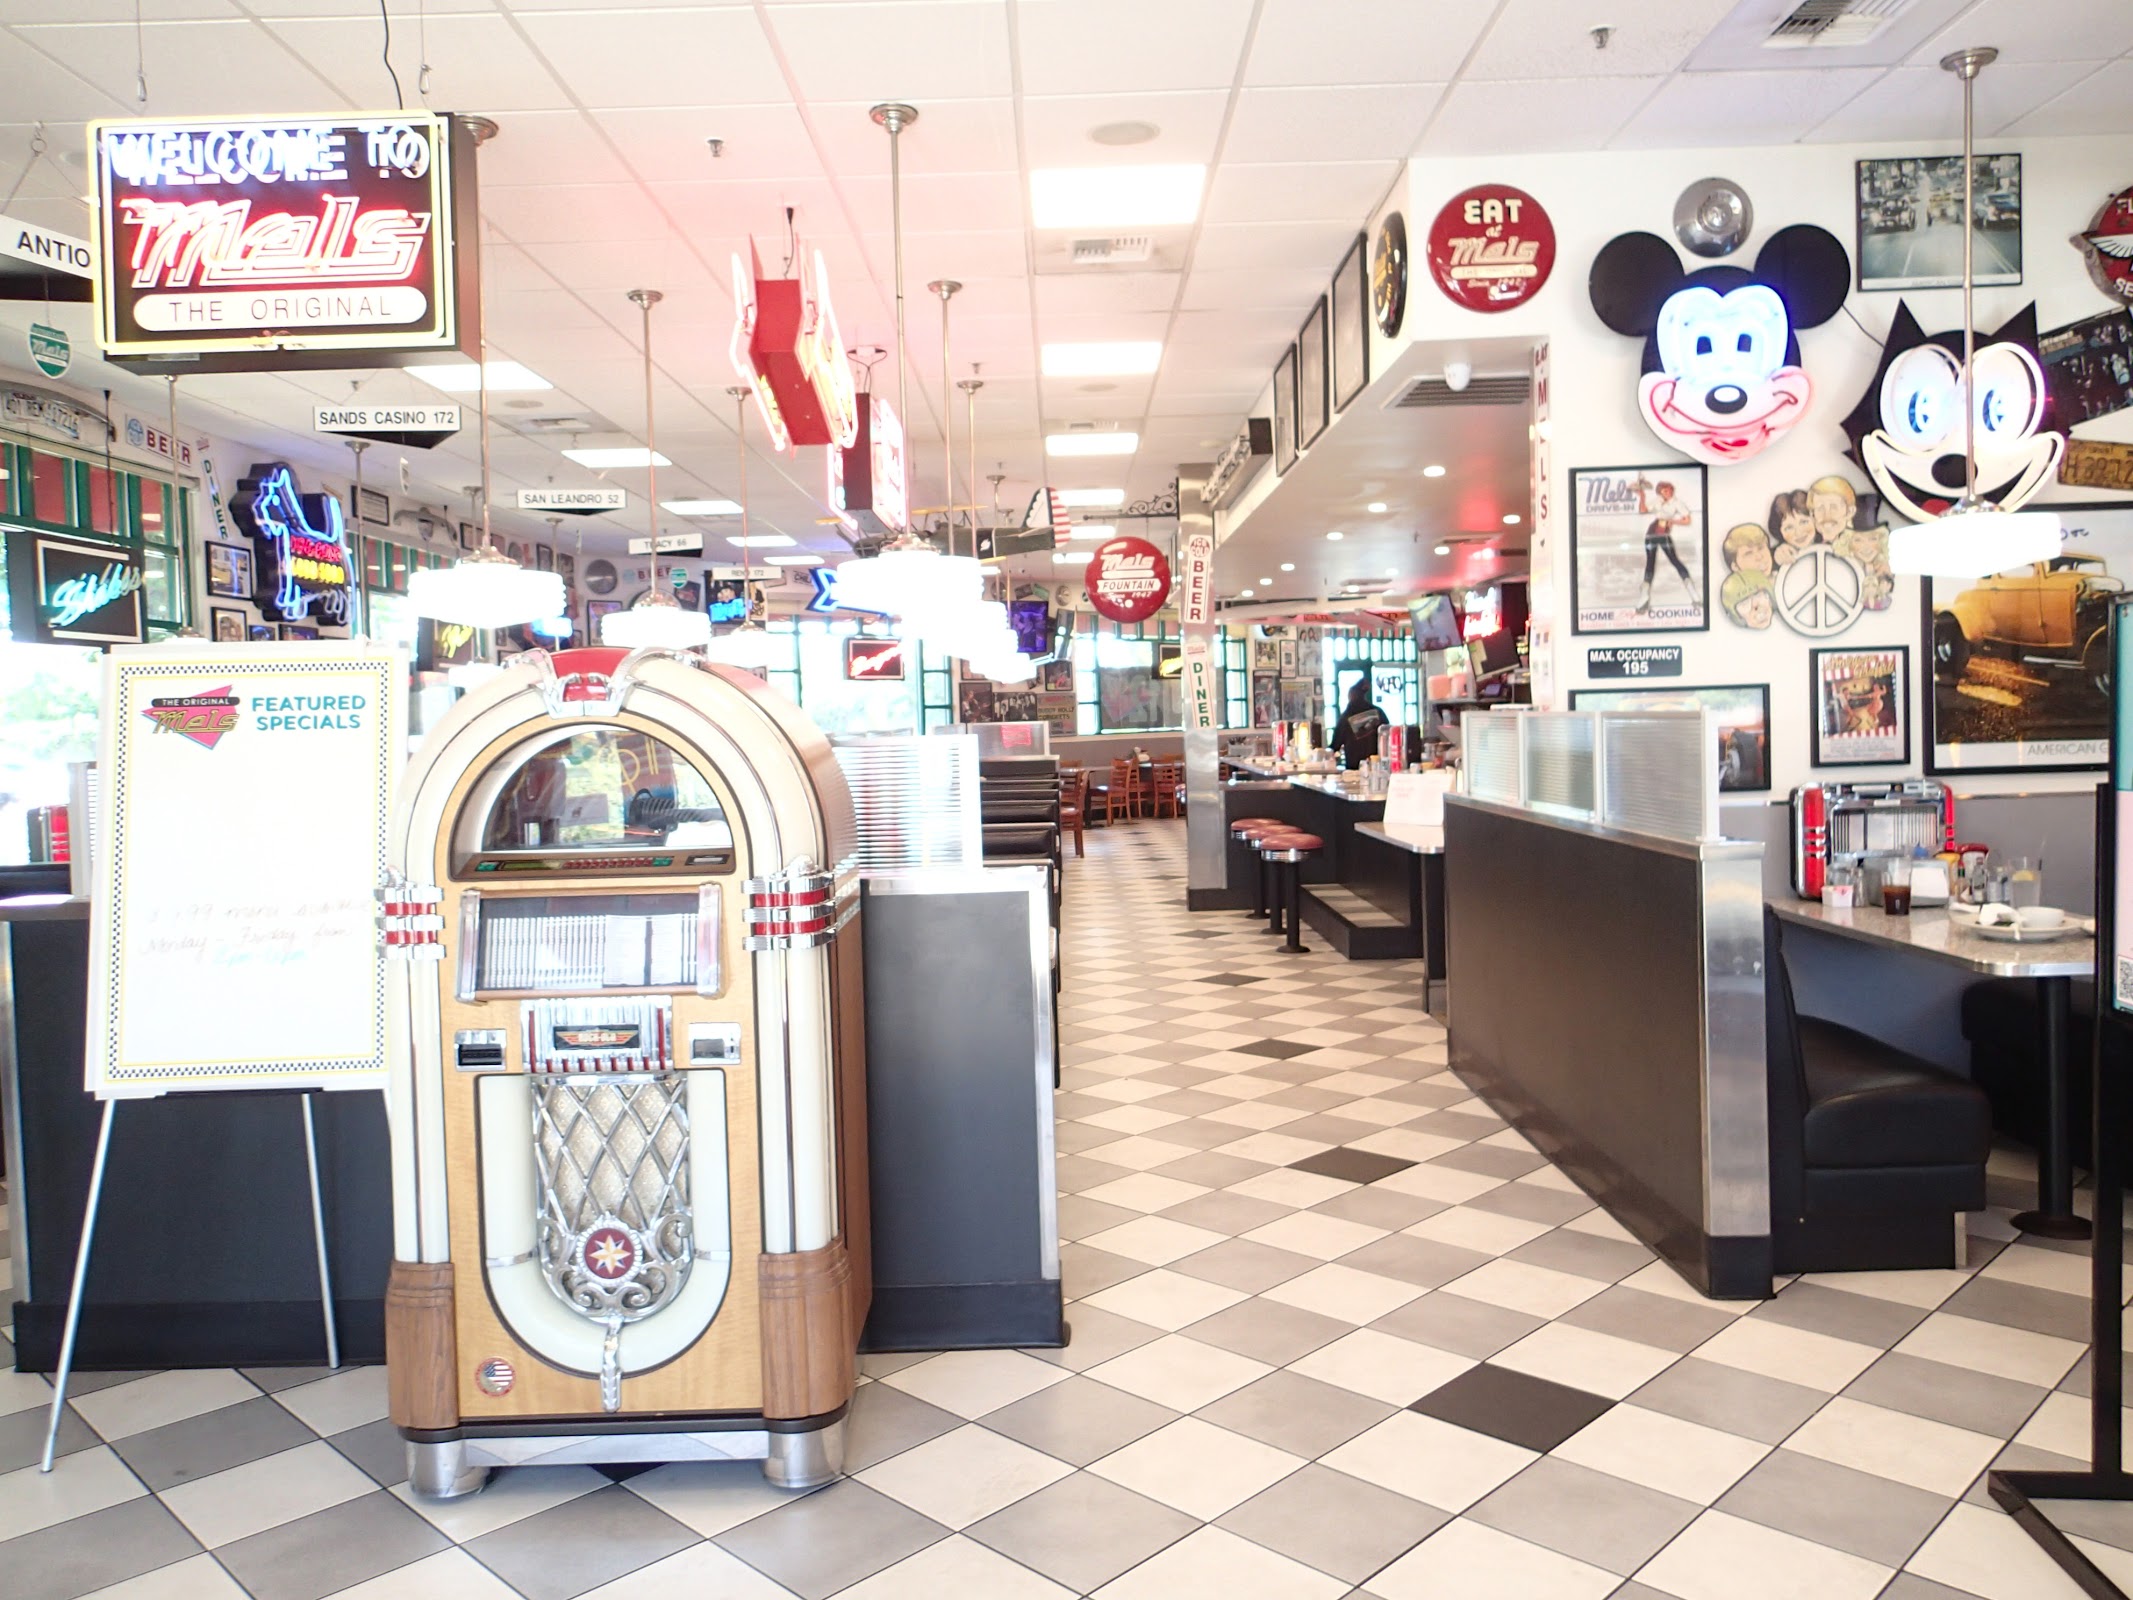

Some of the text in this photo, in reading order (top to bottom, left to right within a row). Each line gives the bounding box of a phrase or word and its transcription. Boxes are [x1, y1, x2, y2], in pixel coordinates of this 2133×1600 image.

[109, 124, 430, 186] WELCOME TO
[1463, 198, 1523, 225] EAT
[119, 193, 432, 289] Mels
[1447, 236, 1540, 266] Mels
[169, 296, 392, 323] THE ORIGINAL
[319, 411, 454, 425] SANDS CASINO 172
[524, 494, 619, 504] SAN LEANDRO 52
[1586, 503, 1635, 514] DRIVE-IN
[644, 540, 672, 550] TACY
[1100, 553, 1155, 571] Mels
[1102, 580, 1155, 591] FOUNTAIN
[1189, 560, 1204, 620] BEER
[1580, 612, 1615, 621] HOME
[1648, 607, 1701, 619] COOKING
[1589, 648, 1680, 662] MAX. OCCUPANCY
[1622, 661, 1649, 675] 195
[162, 697, 230, 706] THE ORIGINAL
[1193, 662, 1211, 727] DINER
[252, 695, 366, 712] FEATURED
[151, 709, 240, 734] Mels
[256, 714, 361, 731] SPECIALS
[2028, 742, 2096, 756] AMERICAN
